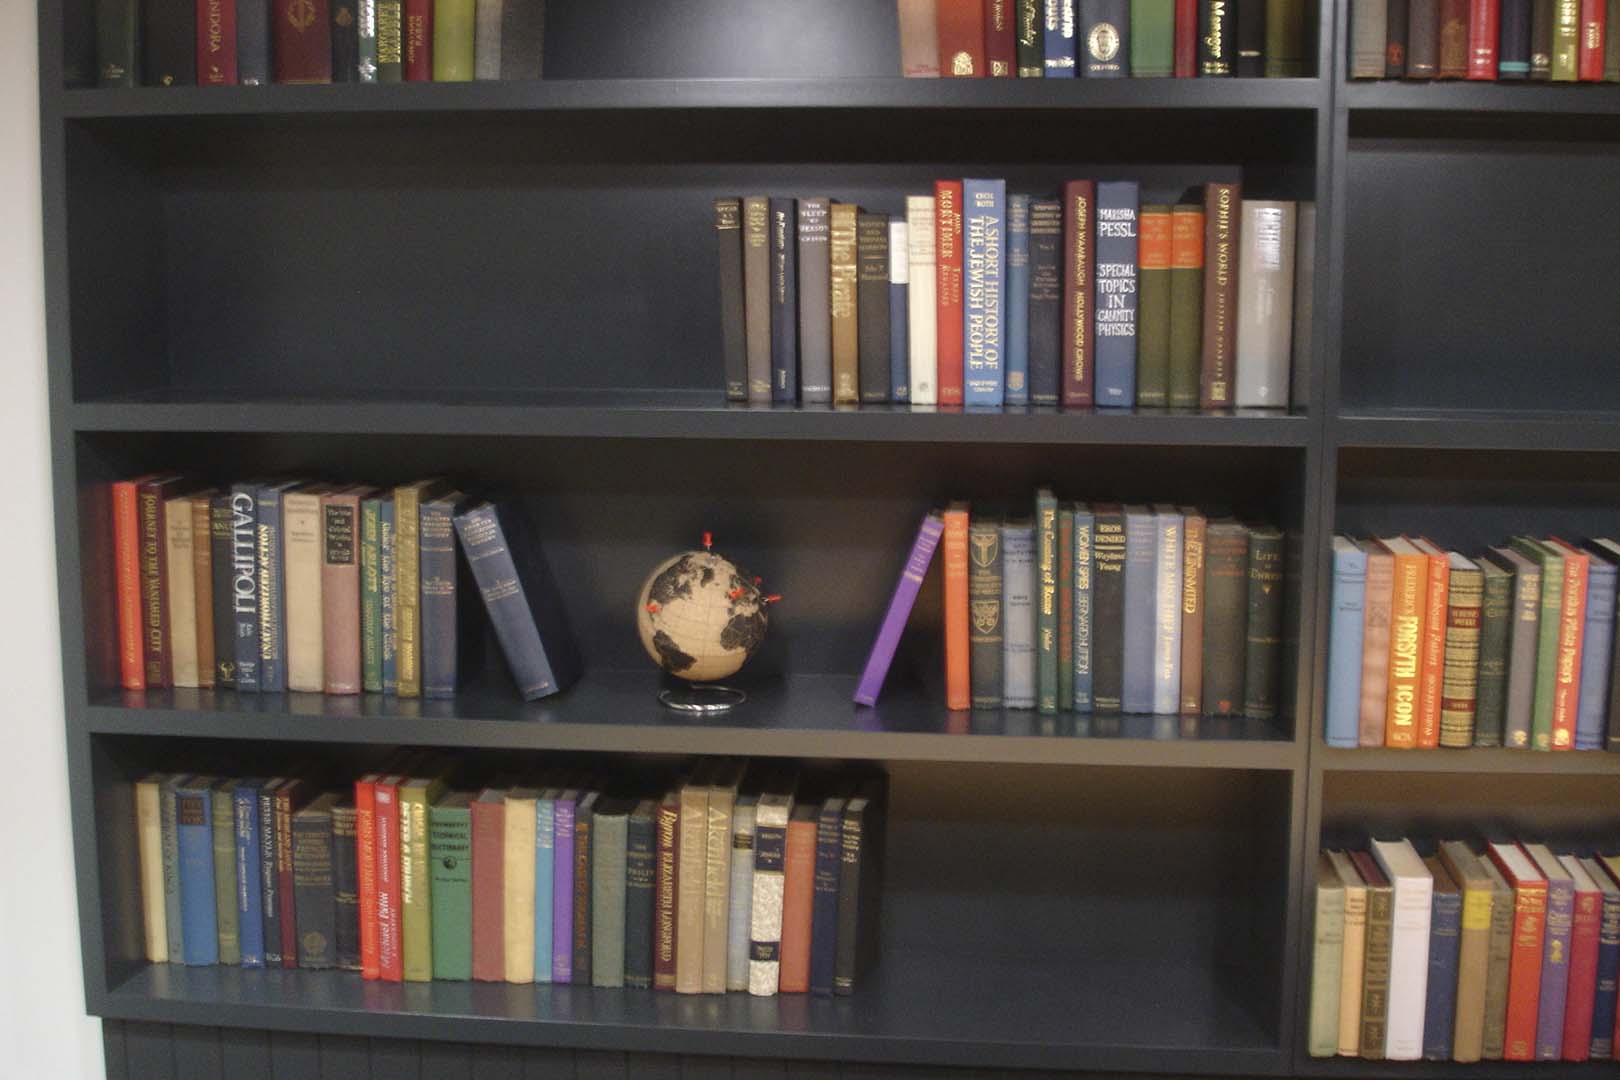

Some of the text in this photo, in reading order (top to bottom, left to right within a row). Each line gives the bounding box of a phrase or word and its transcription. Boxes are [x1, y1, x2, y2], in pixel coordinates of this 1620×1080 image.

[940, 190, 952, 258] MORTIMER
[969, 216, 984, 247] THE
[1076, 196, 1086, 230] JOSEPH
[1099, 208, 1136, 220] MARISHA
[1099, 222, 1136, 238] PESSL
[968, 248, 984, 309] JEWISH
[1099, 264, 1136, 277] SPECIAL
[1217, 243, 1228, 286] WORLD
[984, 216, 1000, 369] A SHORT HISTORY OF
[1099, 279, 1136, 293] TOPICS
[1107, 295, 1124, 308] IN
[1098, 310, 1134, 322] CALAMITY
[1098, 324, 1136, 336] PHYSICS
[968, 314, 984, 370] PEOPLE
[144, 494, 157, 539] JOURNEY
[232, 492, 256, 614] GALLIPOLI
[1078, 526, 1090, 565] WOMEN
[1095, 534, 1126, 543] DENIED
[1395, 616, 1418, 678] FORSYTH
[1395, 684, 1414, 726] ICON
[661, 810, 677, 962] Byron ELIZABETH LONGFORD
